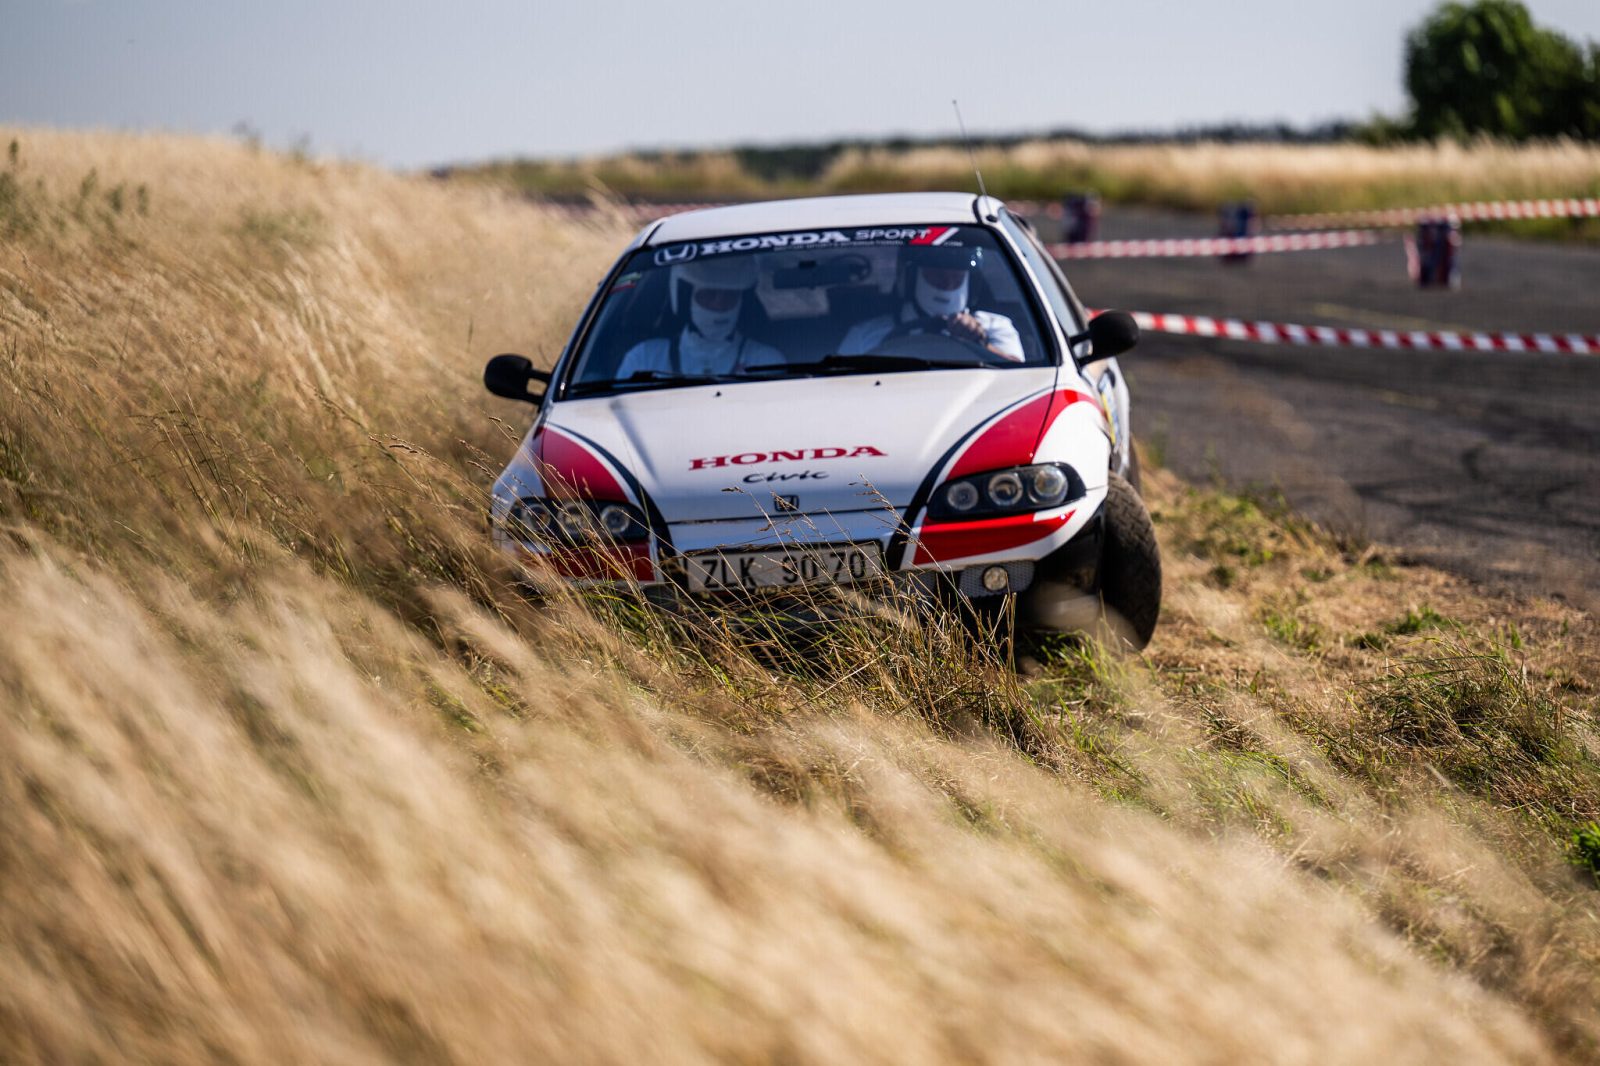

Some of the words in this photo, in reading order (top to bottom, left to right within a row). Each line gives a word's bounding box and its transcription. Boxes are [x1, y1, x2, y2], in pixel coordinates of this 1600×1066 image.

[701, 231, 850, 255] HONDA
[854, 229, 931, 240] SPORT
[688, 446, 888, 470] HONDA
[702, 557, 756, 588] ZLK
[830, 551, 865, 580] 70
